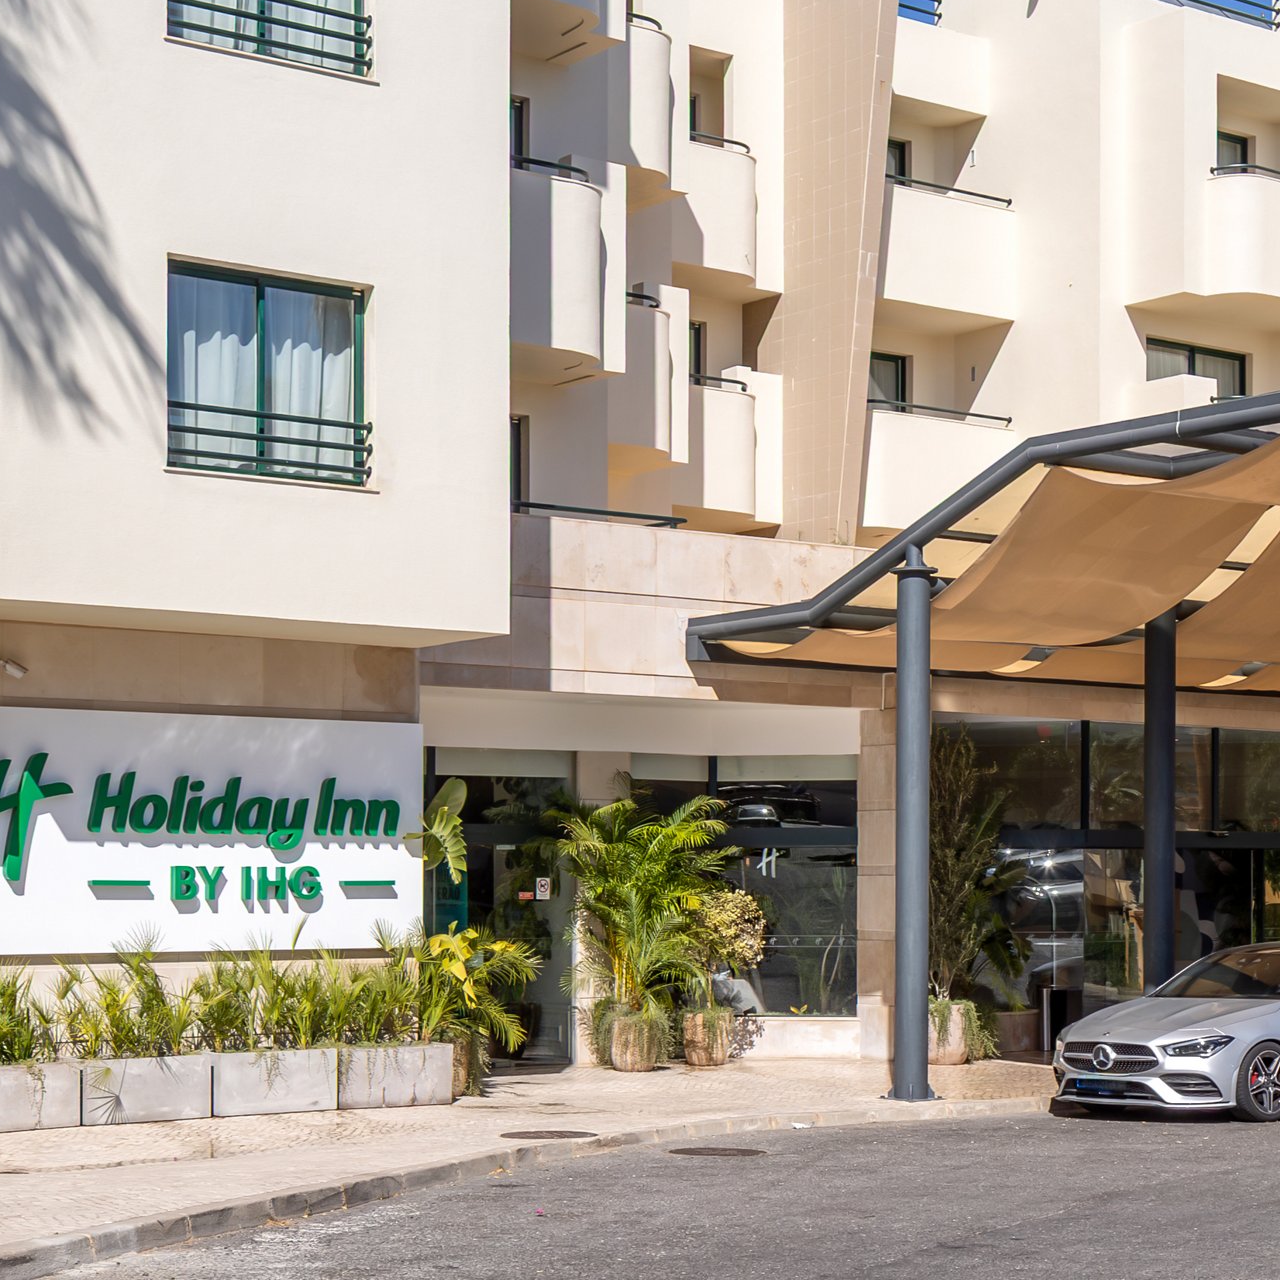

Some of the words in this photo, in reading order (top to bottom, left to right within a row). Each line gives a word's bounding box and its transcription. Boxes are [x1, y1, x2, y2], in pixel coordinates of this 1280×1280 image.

[87, 771, 309, 850] Holiday
[314, 777, 401, 837] Inn
[170, 865, 224, 901] BY
[240, 865, 322, 901] IHG
